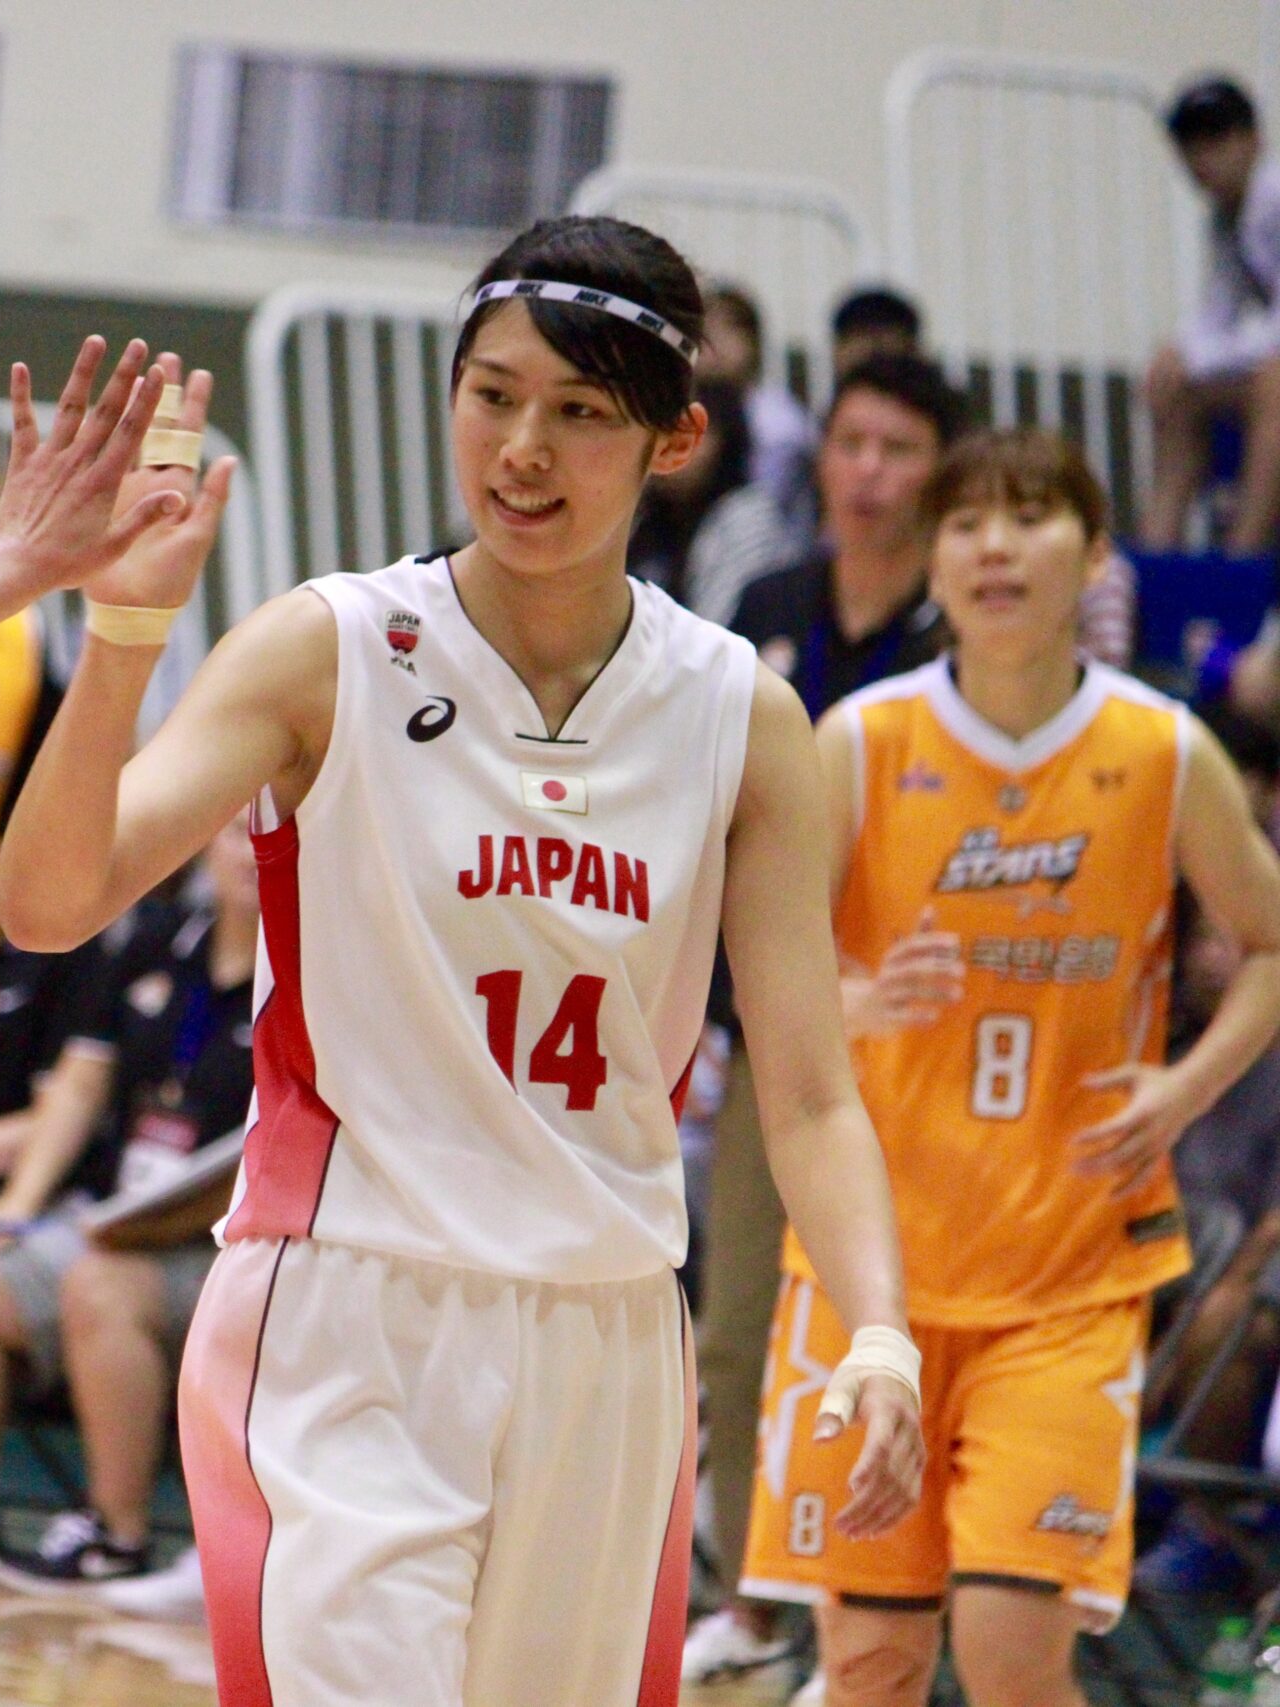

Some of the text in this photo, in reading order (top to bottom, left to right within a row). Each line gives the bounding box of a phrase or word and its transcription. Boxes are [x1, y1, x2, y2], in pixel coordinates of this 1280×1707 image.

[388, 612, 421, 627] JAPAN
[457, 834, 651, 924] JAPAN
[474, 969, 608, 1112] 14
[971, 1011, 1035, 1121] 8
[788, 1490, 827, 1557] 8
